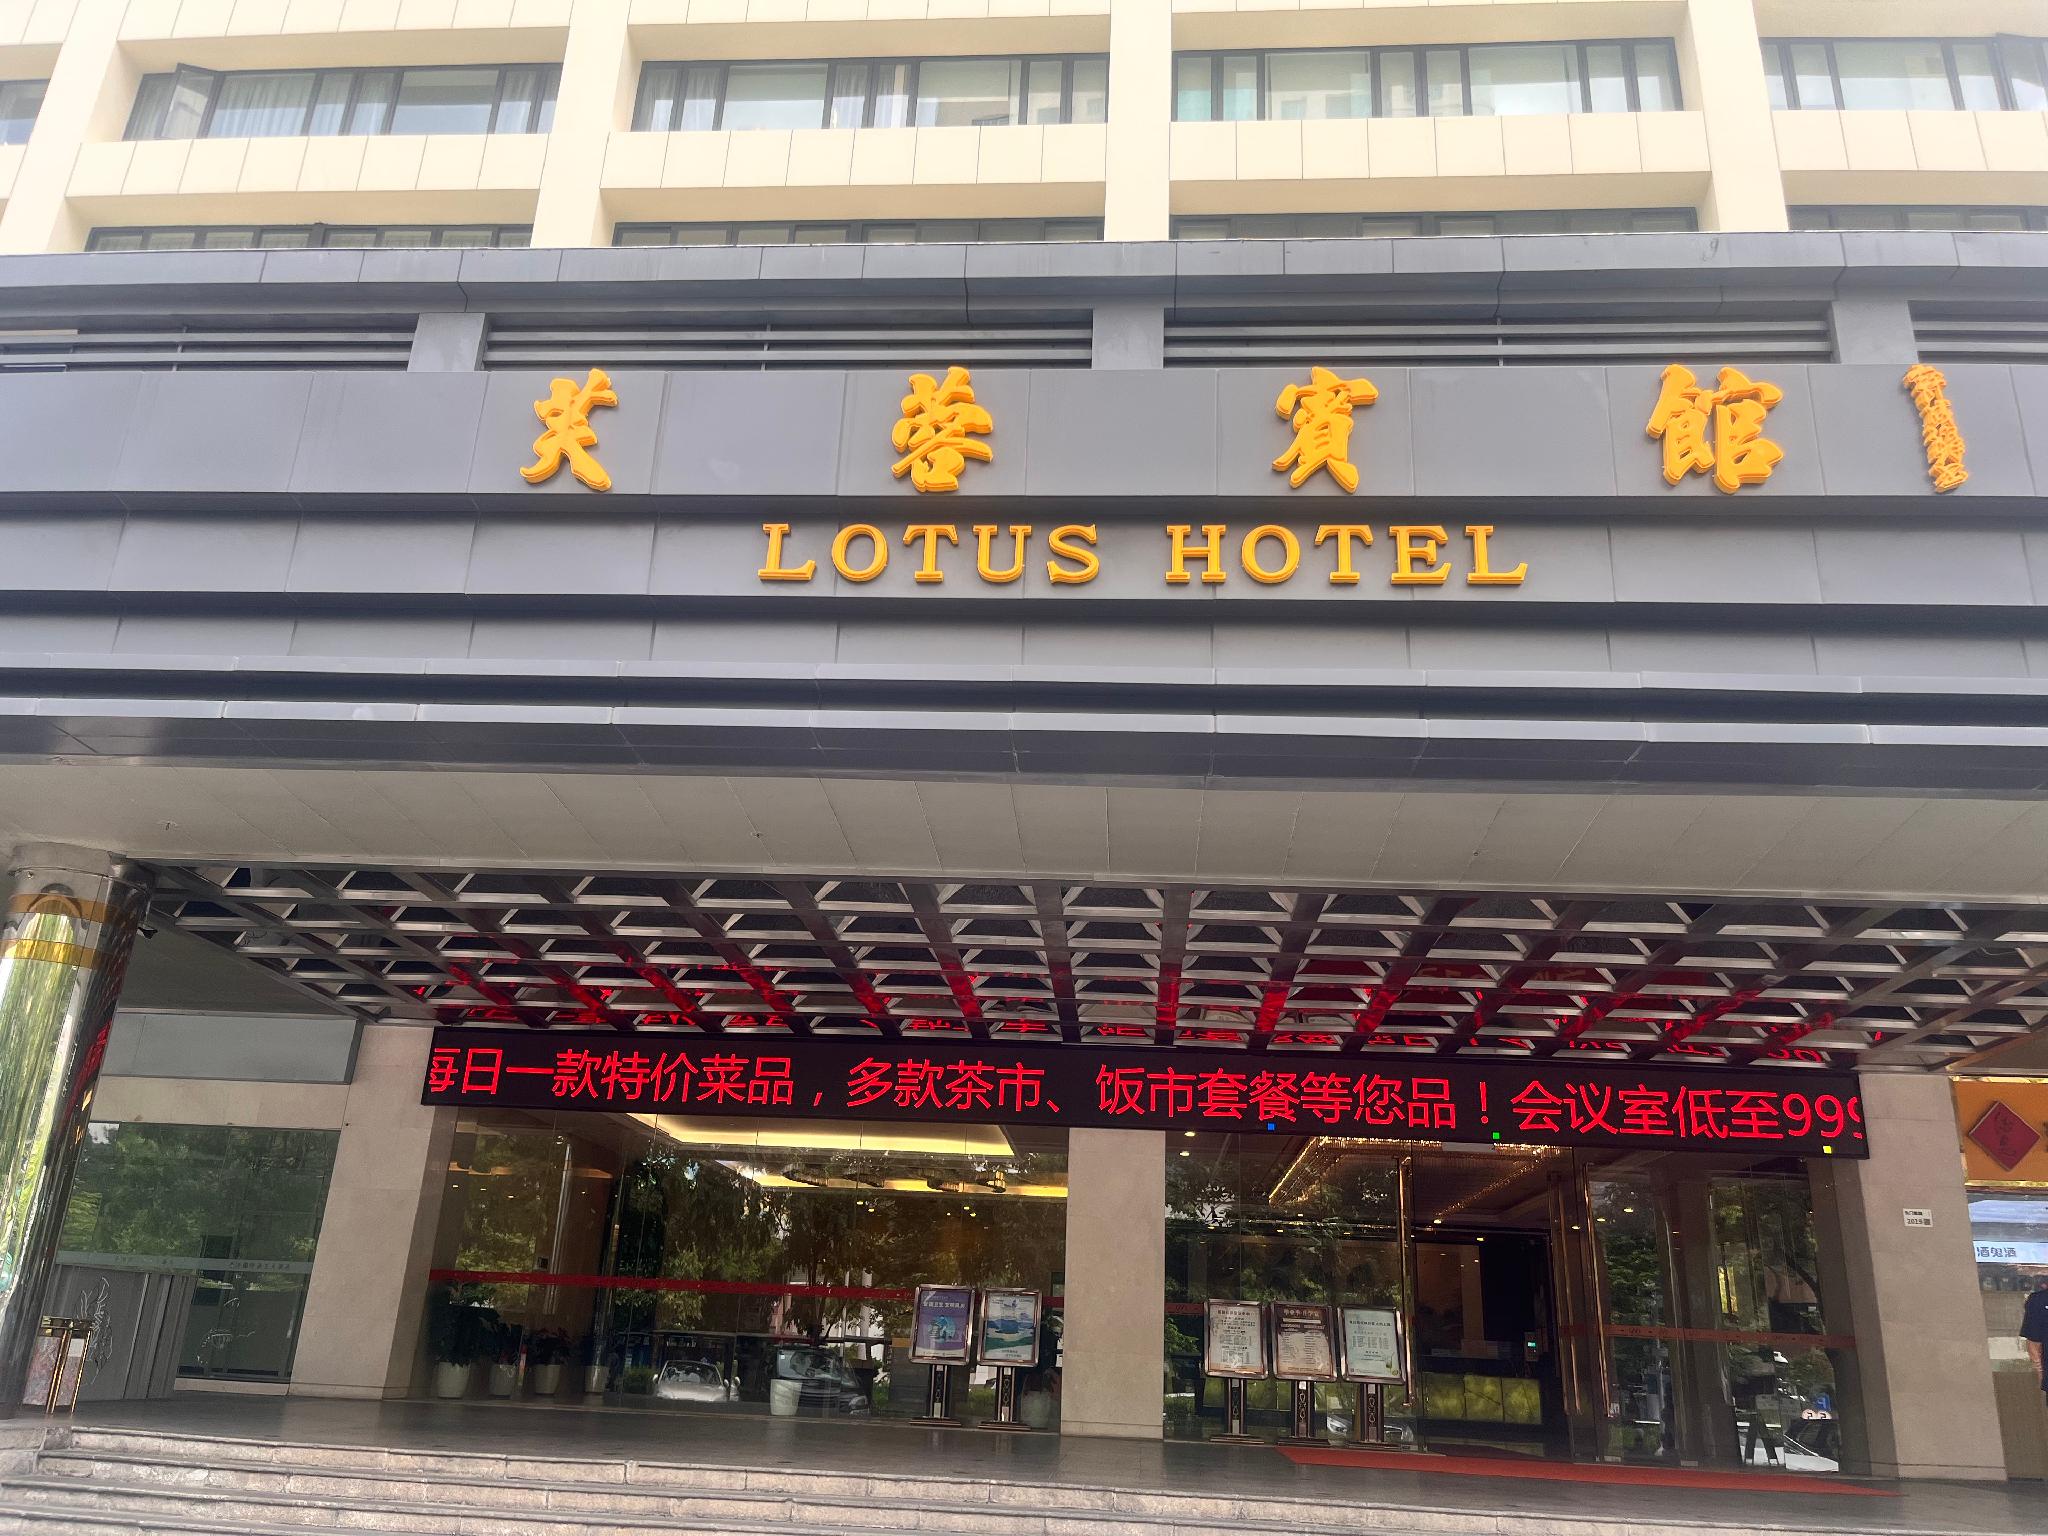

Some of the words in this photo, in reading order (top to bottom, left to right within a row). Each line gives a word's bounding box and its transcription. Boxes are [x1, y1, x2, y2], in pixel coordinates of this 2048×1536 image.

[757, 522, 1101, 583] LOTUS
[1165, 523, 1529, 585] HOTEL
[1976, 1246, 2018, 1258] 酒鬼酒
